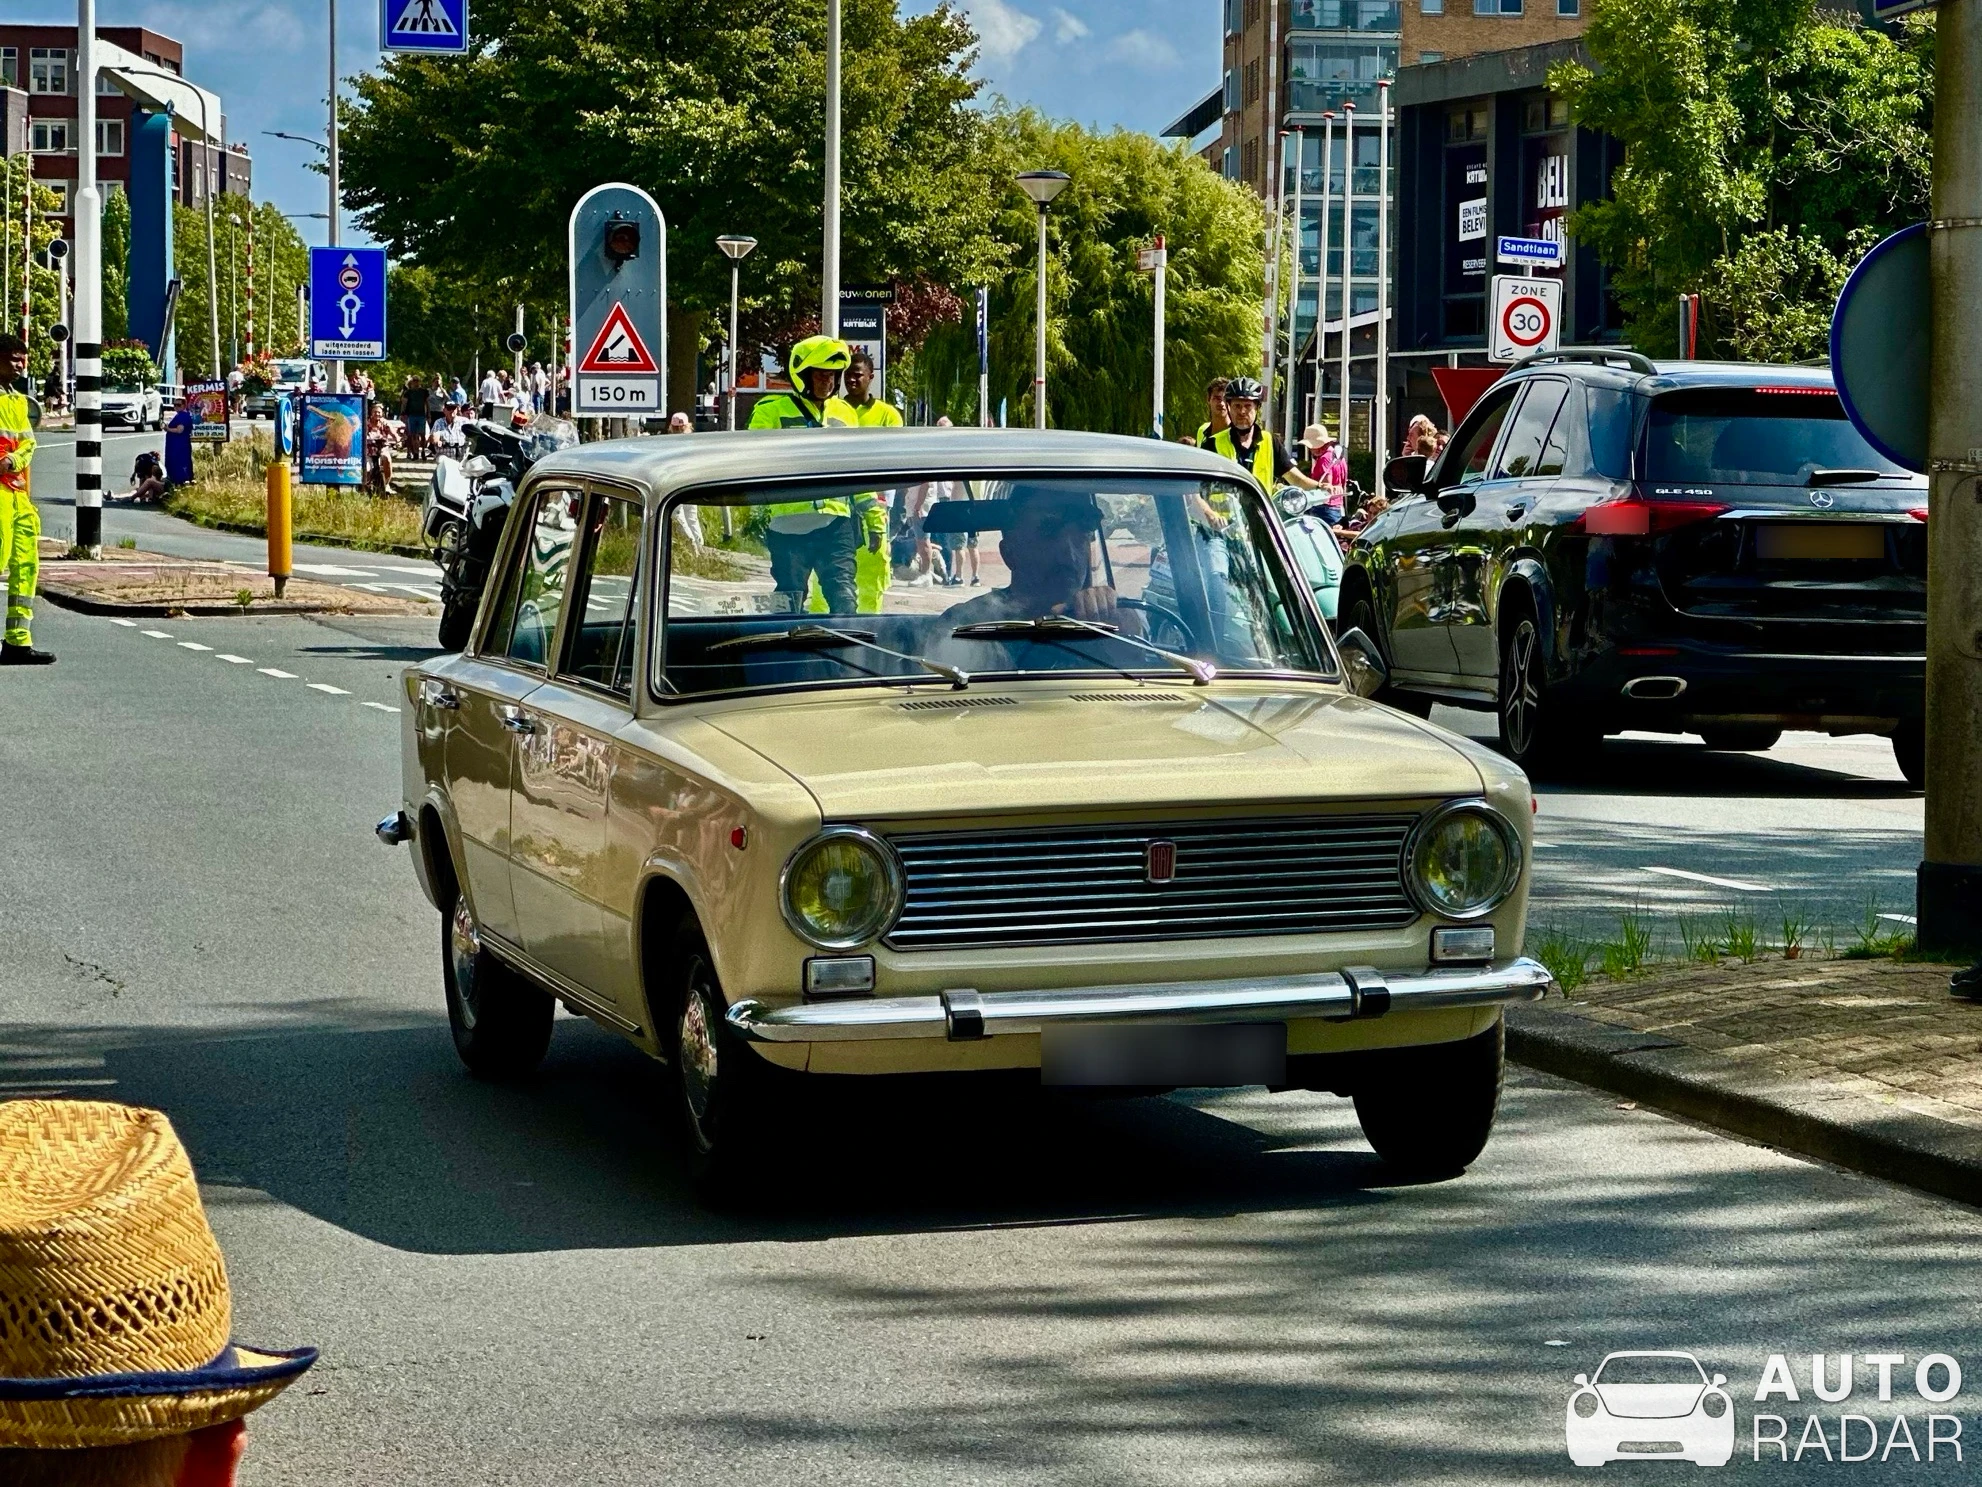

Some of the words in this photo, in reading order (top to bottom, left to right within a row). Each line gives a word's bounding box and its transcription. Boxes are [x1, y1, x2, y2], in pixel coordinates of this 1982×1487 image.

[1503, 241, 1556, 256] Sandtlaan
[1511, 285, 1547, 297] ZONE
[1513, 313, 1541, 332] 30
[187, 382, 225, 394] KERMIS
[591, 386, 626, 402] 150
[629, 389, 646, 402] m
[305, 456, 362, 466] Monsterlijk
